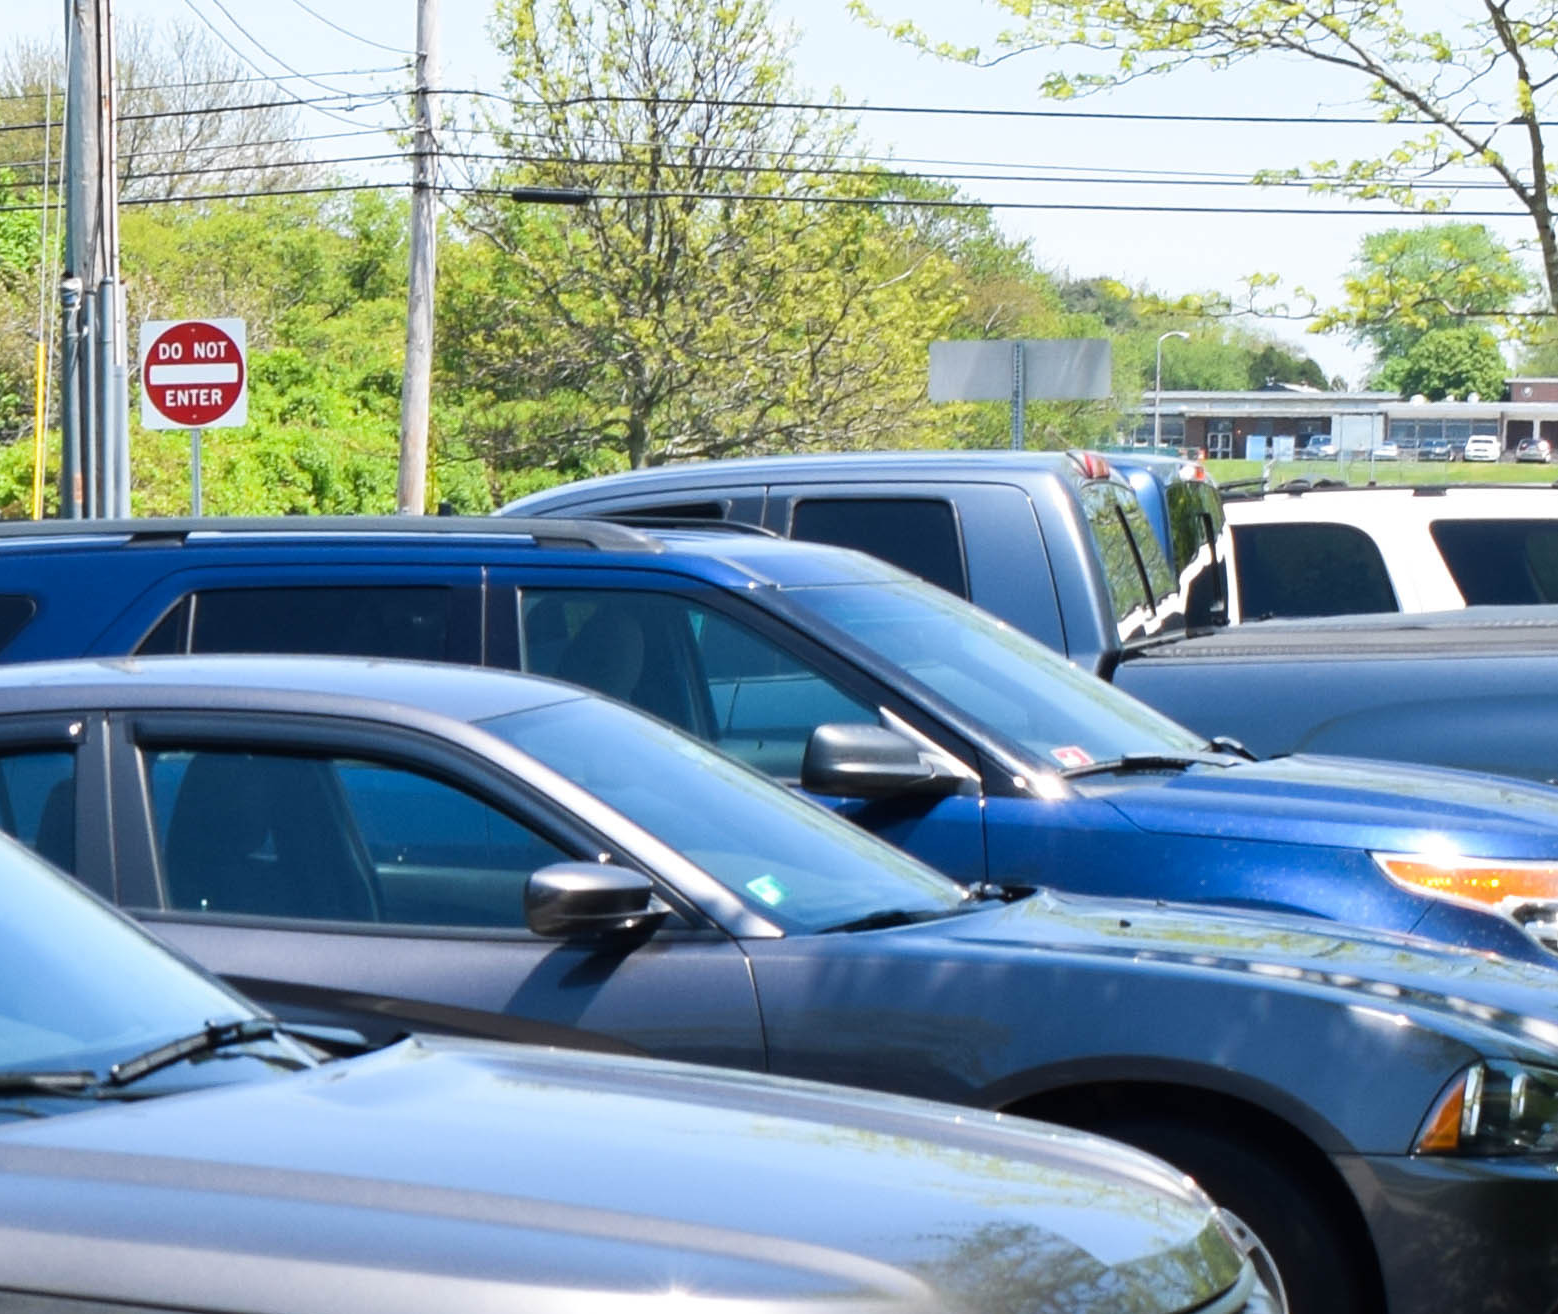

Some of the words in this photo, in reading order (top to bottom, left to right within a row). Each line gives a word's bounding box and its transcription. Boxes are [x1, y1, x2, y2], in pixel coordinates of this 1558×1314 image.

[158, 342, 183, 360] DO
[193, 341, 227, 359] NOT
[165, 389, 222, 407] ENTER
